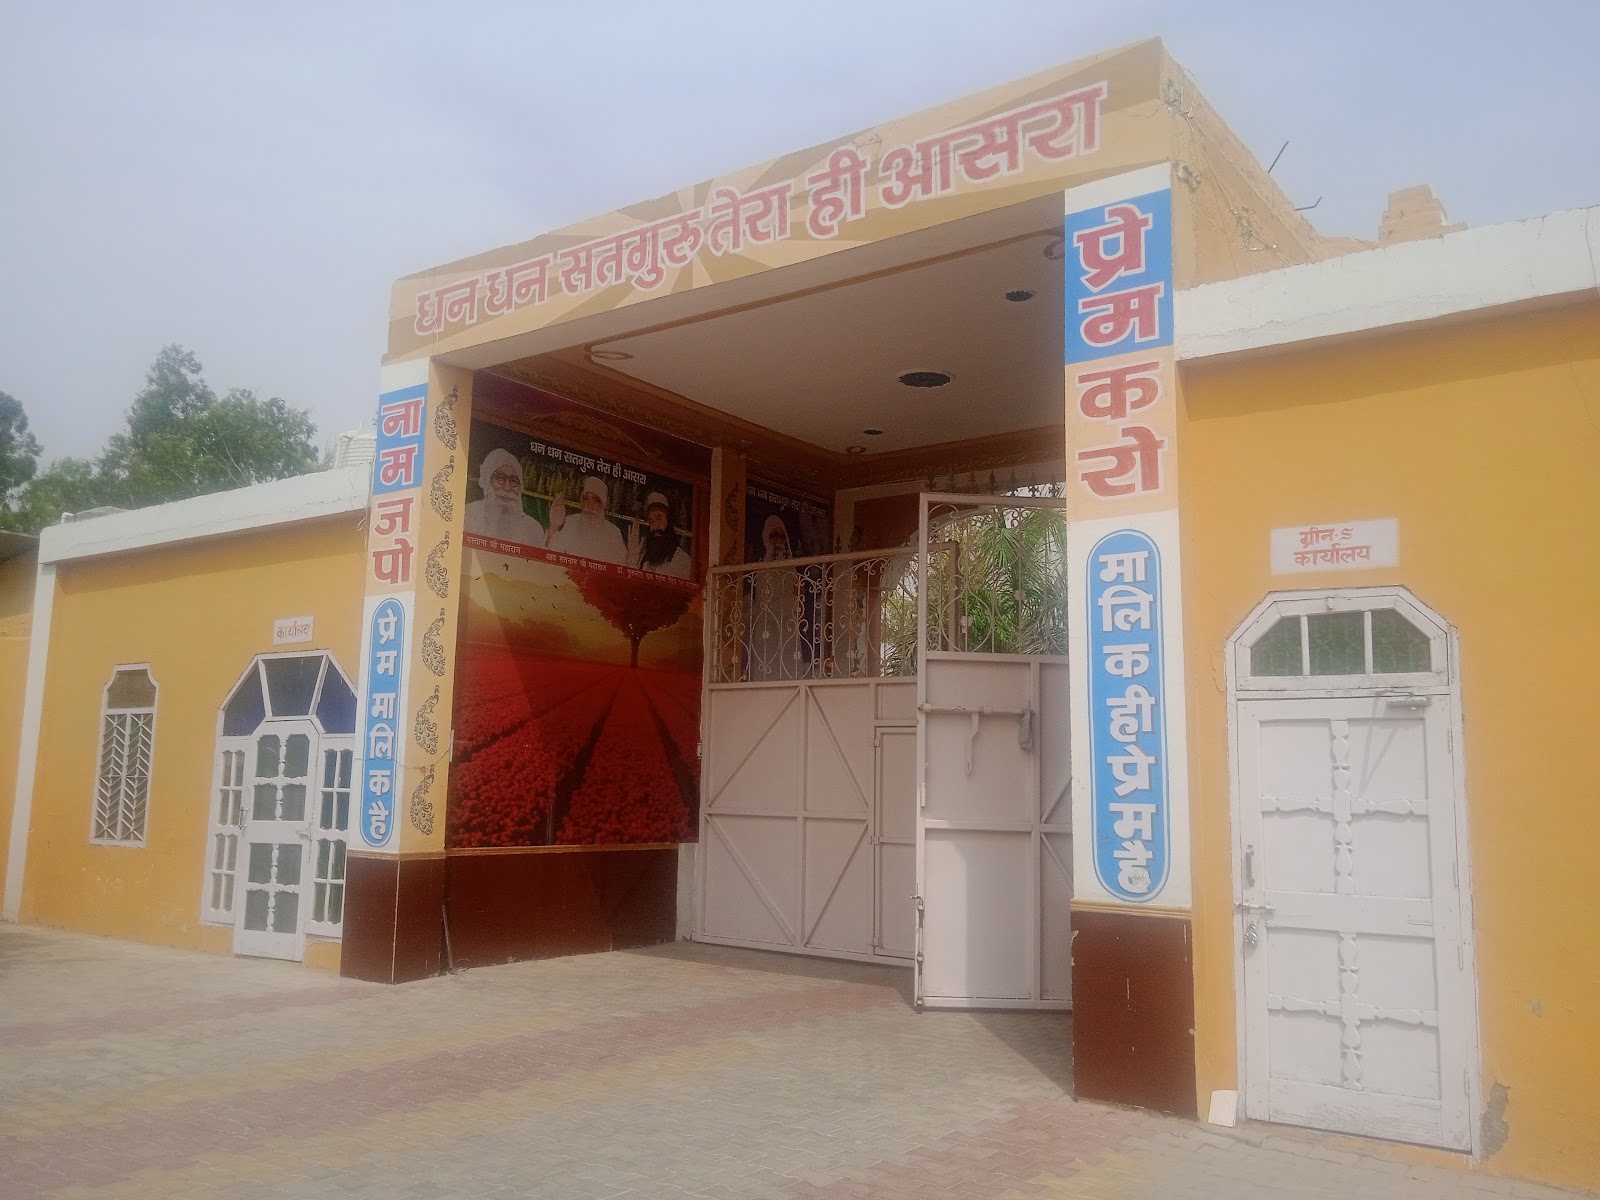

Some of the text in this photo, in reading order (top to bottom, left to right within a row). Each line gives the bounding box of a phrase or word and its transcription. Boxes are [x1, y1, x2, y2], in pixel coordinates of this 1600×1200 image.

[414, 276, 481, 335] धन
[485, 253, 553, 315] धन
[708, 182, 793, 256] तेरा
[806, 143, 871, 239] ही
[879, 81, 1108, 208] आसरा
[1074, 204, 1166, 498] प्रेम करो
[373, 397, 424, 584] नाम जपो
[530, 441, 545, 455] धन
[548, 446, 562, 460] धन
[597, 458, 611, 475] तेरा
[612, 463, 621, 478] ही
[623, 469, 647, 485] आसरा
[1293, 543, 1373, 566] कार्यालय
[276, 620, 309, 639] कार्यालय
[376, 608, 398, 676] प्रेम
[1106, 685, 1156, 744] ही
[368, 800, 390, 841] है
[1107, 744, 1156, 841] प्रेम
